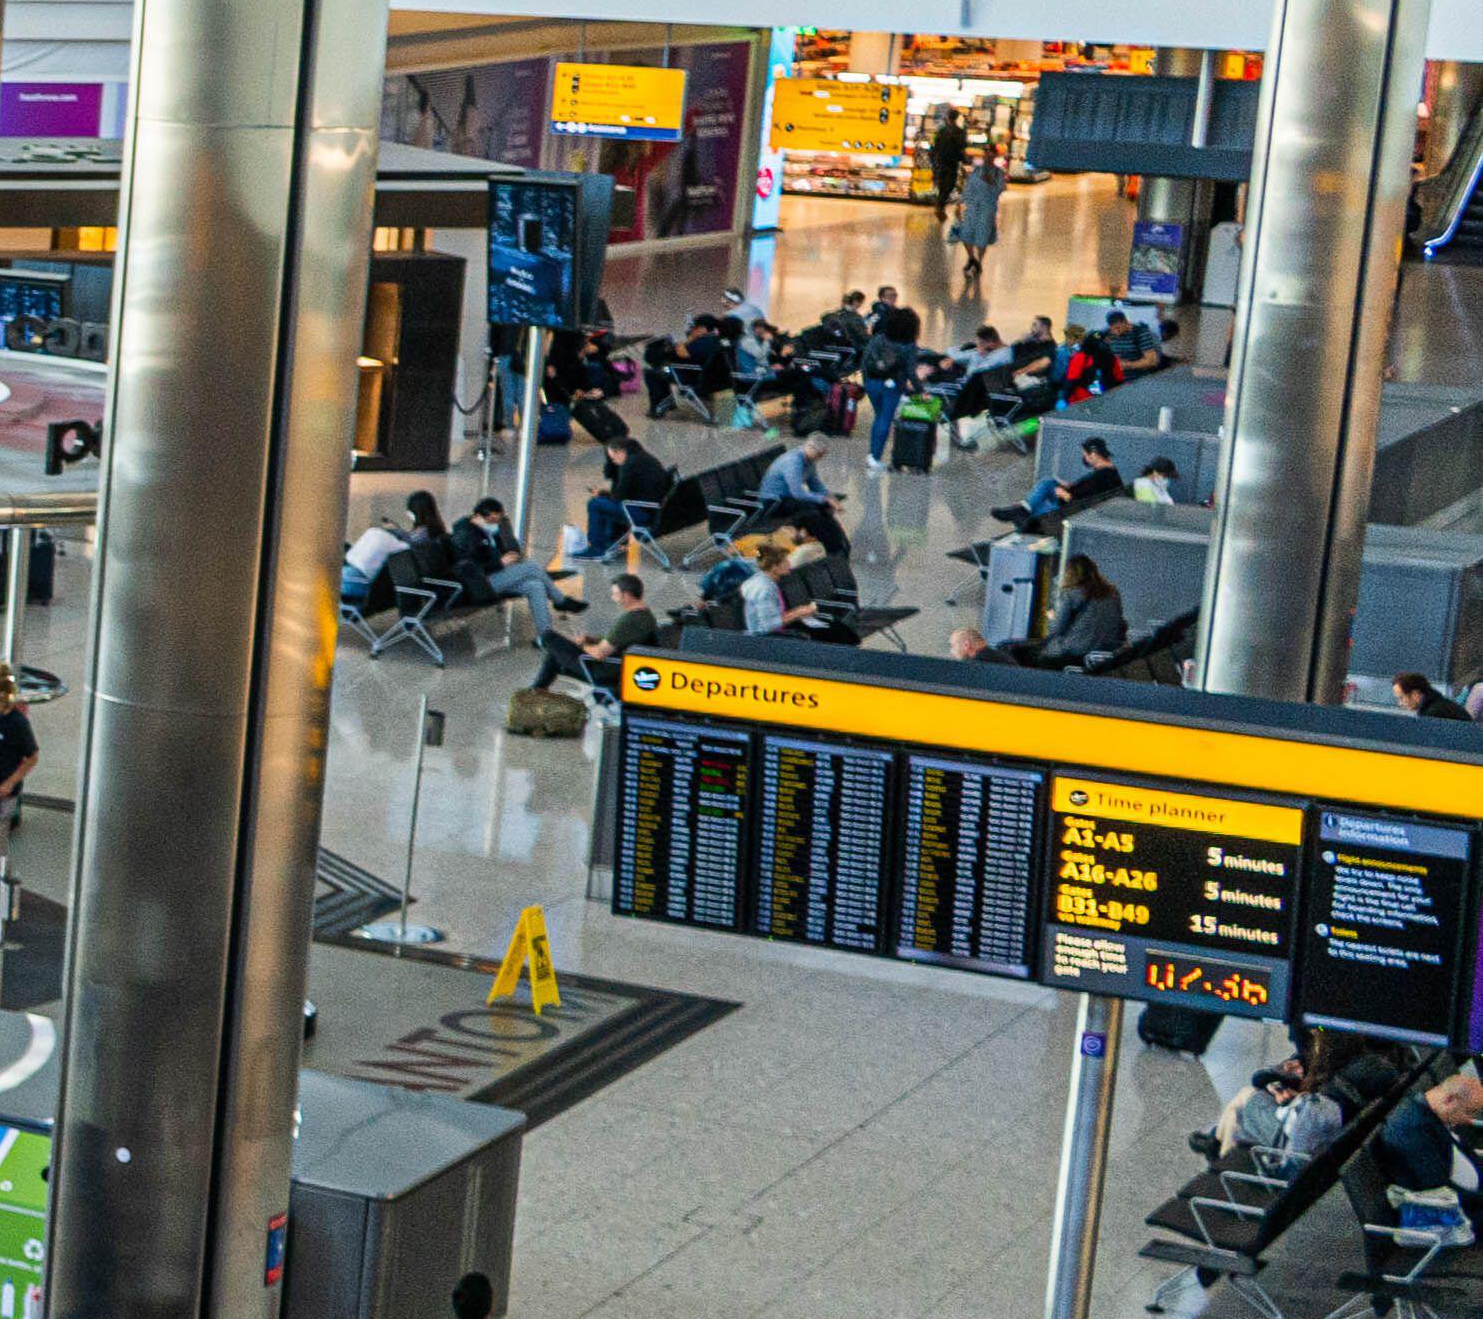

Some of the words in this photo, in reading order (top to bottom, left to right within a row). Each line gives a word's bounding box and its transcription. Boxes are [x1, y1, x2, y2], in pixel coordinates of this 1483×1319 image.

[670, 671, 820, 709] Departures
[1097, 793, 1144, 812] Time
[1149, 801, 1227, 823] planner
[1062, 827, 1134, 852] A1-A5
[1207, 846, 1223, 867] 5
[1223, 855, 1286, 876] minutes
[1204, 880, 1221, 901] 5
[1220, 889, 1282, 911] minutes
[1217, 923, 1279, 945] minutes
